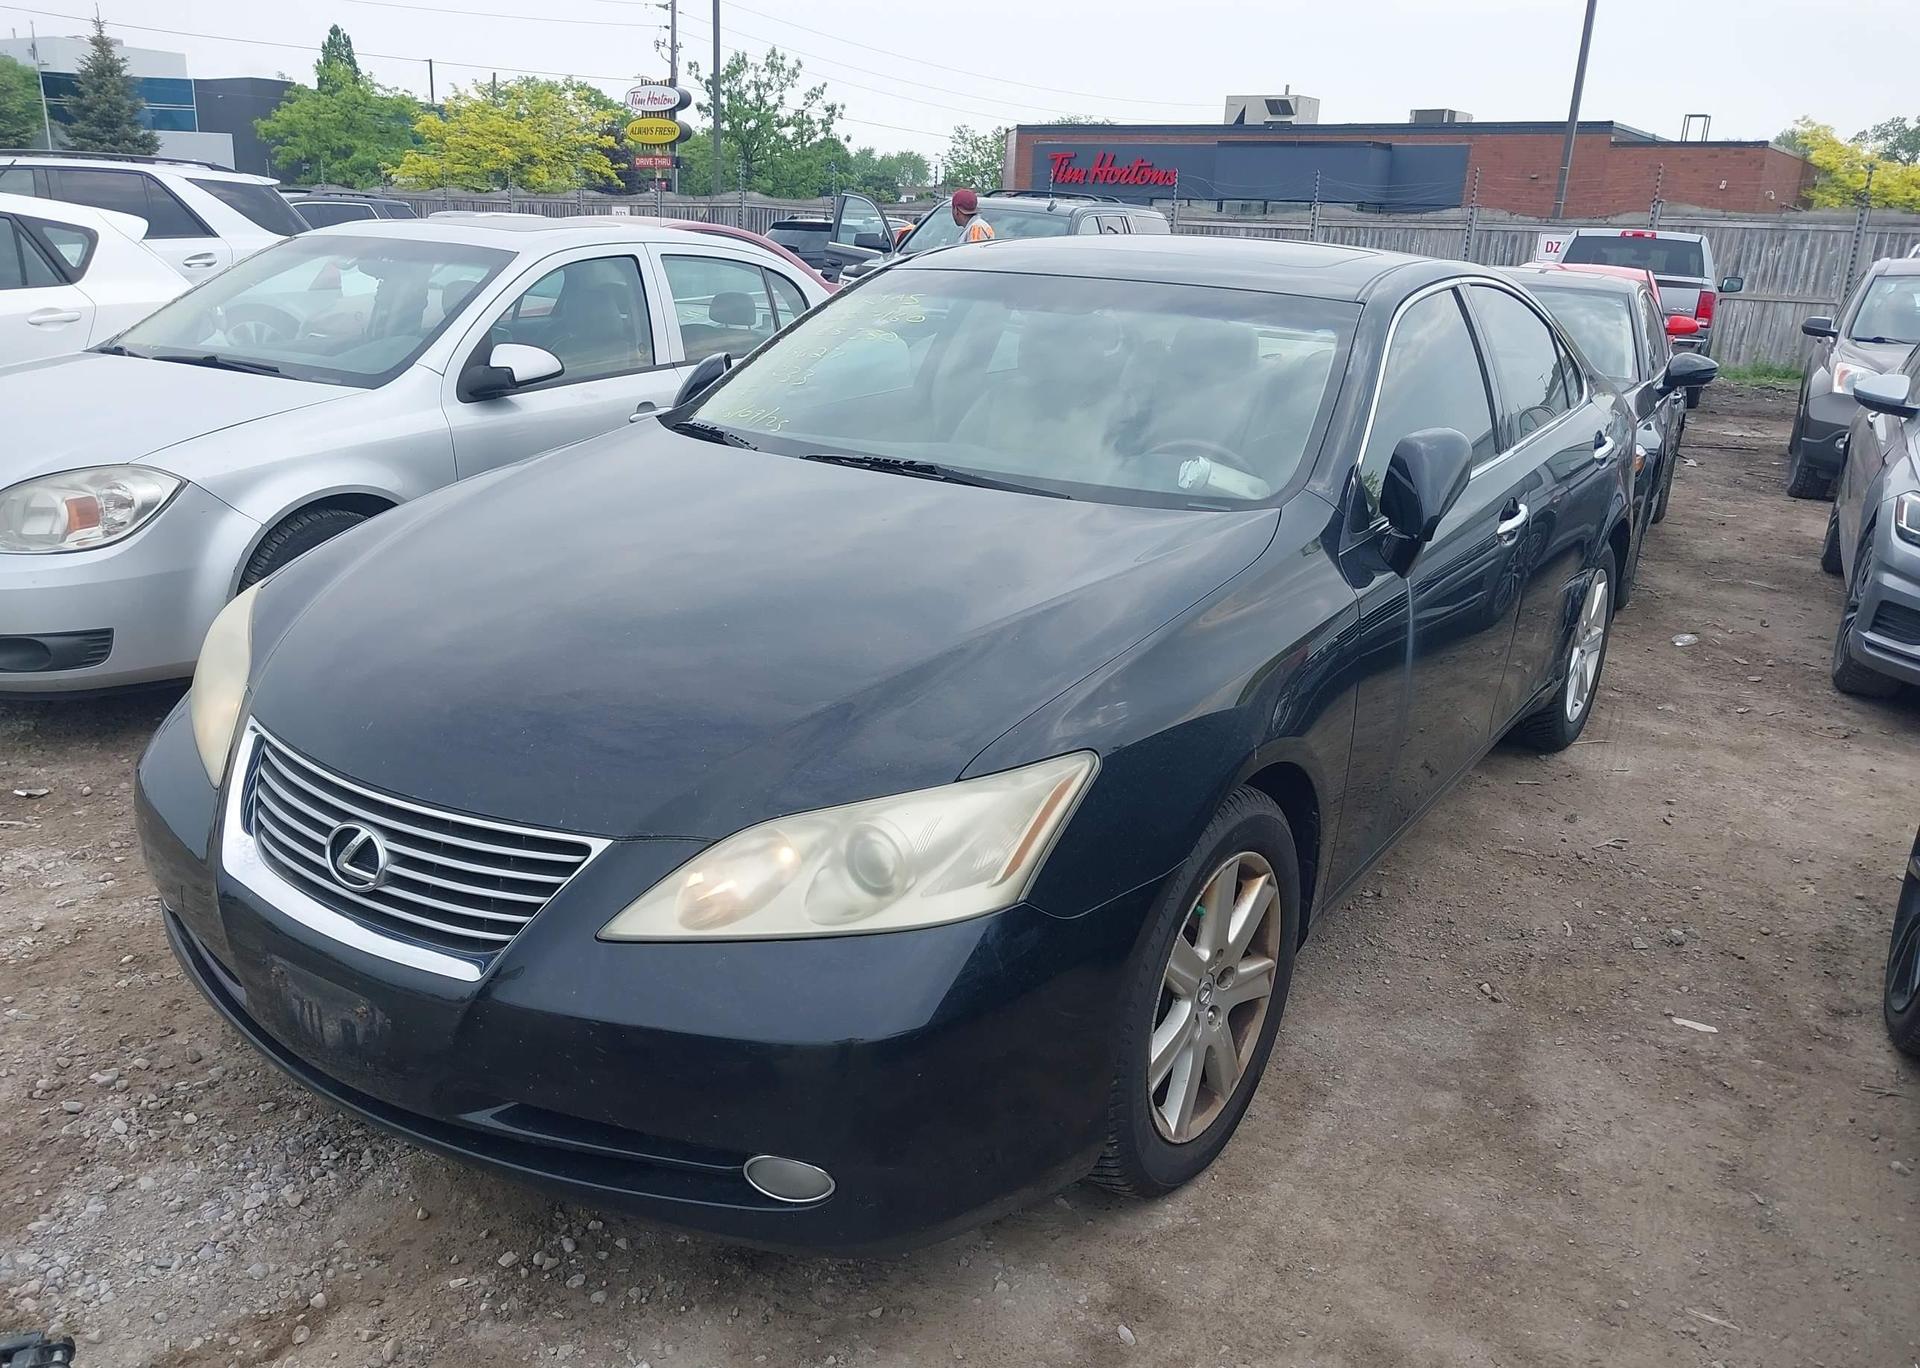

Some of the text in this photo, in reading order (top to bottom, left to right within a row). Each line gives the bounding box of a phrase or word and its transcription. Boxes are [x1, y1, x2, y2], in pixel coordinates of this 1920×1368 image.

[630, 90, 677, 106] Tim Hortons
[629, 126, 677, 136] ALWAYS FRESH
[635, 157, 671, 166] DRIVE THRU
[1048, 149, 1178, 186] Tim Hortons
